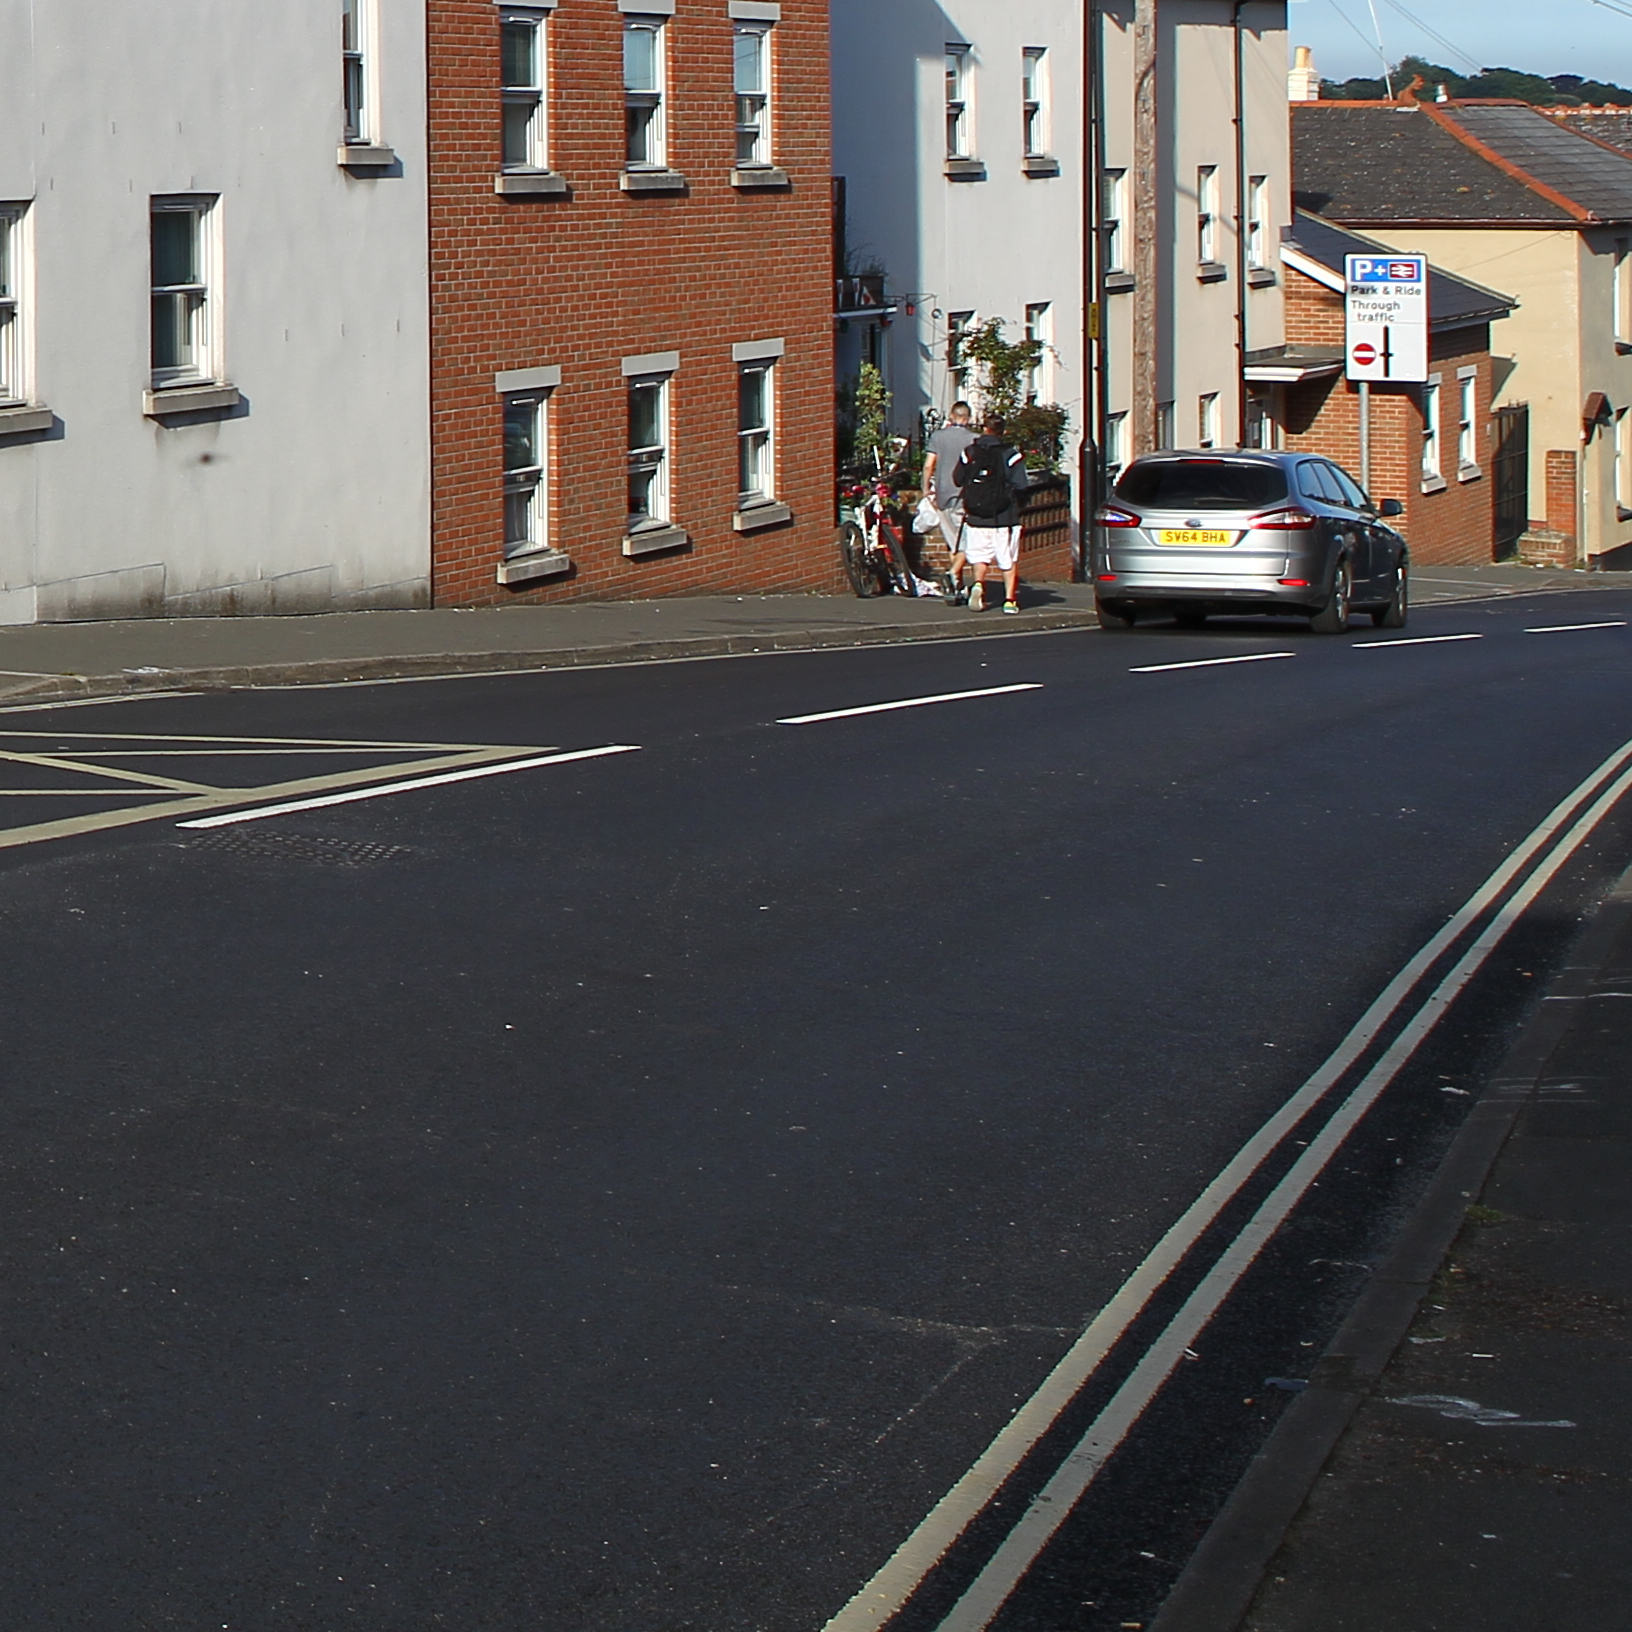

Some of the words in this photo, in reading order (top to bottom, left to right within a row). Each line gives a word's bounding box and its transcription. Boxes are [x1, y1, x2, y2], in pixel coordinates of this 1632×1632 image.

[1350, 285, 1378, 295] Park
[1382, 285, 1391, 295] &
[1394, 285, 1422, 296] Ride
[1350, 299, 1401, 312] Through
[1357, 312, 1395, 322] traffic
[1201, 531, 1227, 543] BHA
